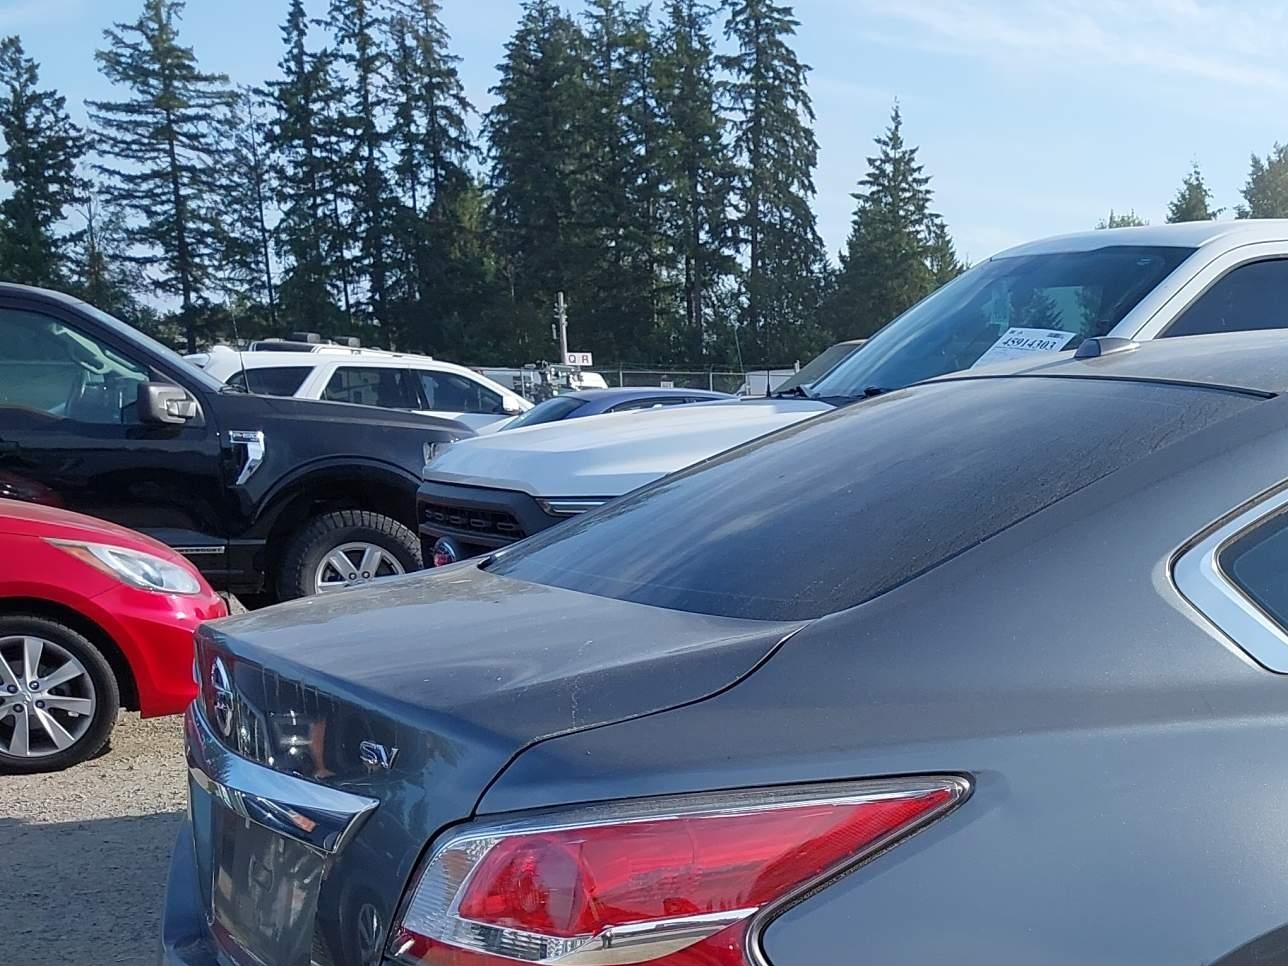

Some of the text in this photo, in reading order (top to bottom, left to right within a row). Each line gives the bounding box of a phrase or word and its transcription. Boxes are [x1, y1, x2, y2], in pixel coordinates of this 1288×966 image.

[568, 354, 589, 364] Q R
[360, 740, 400, 769] SV
